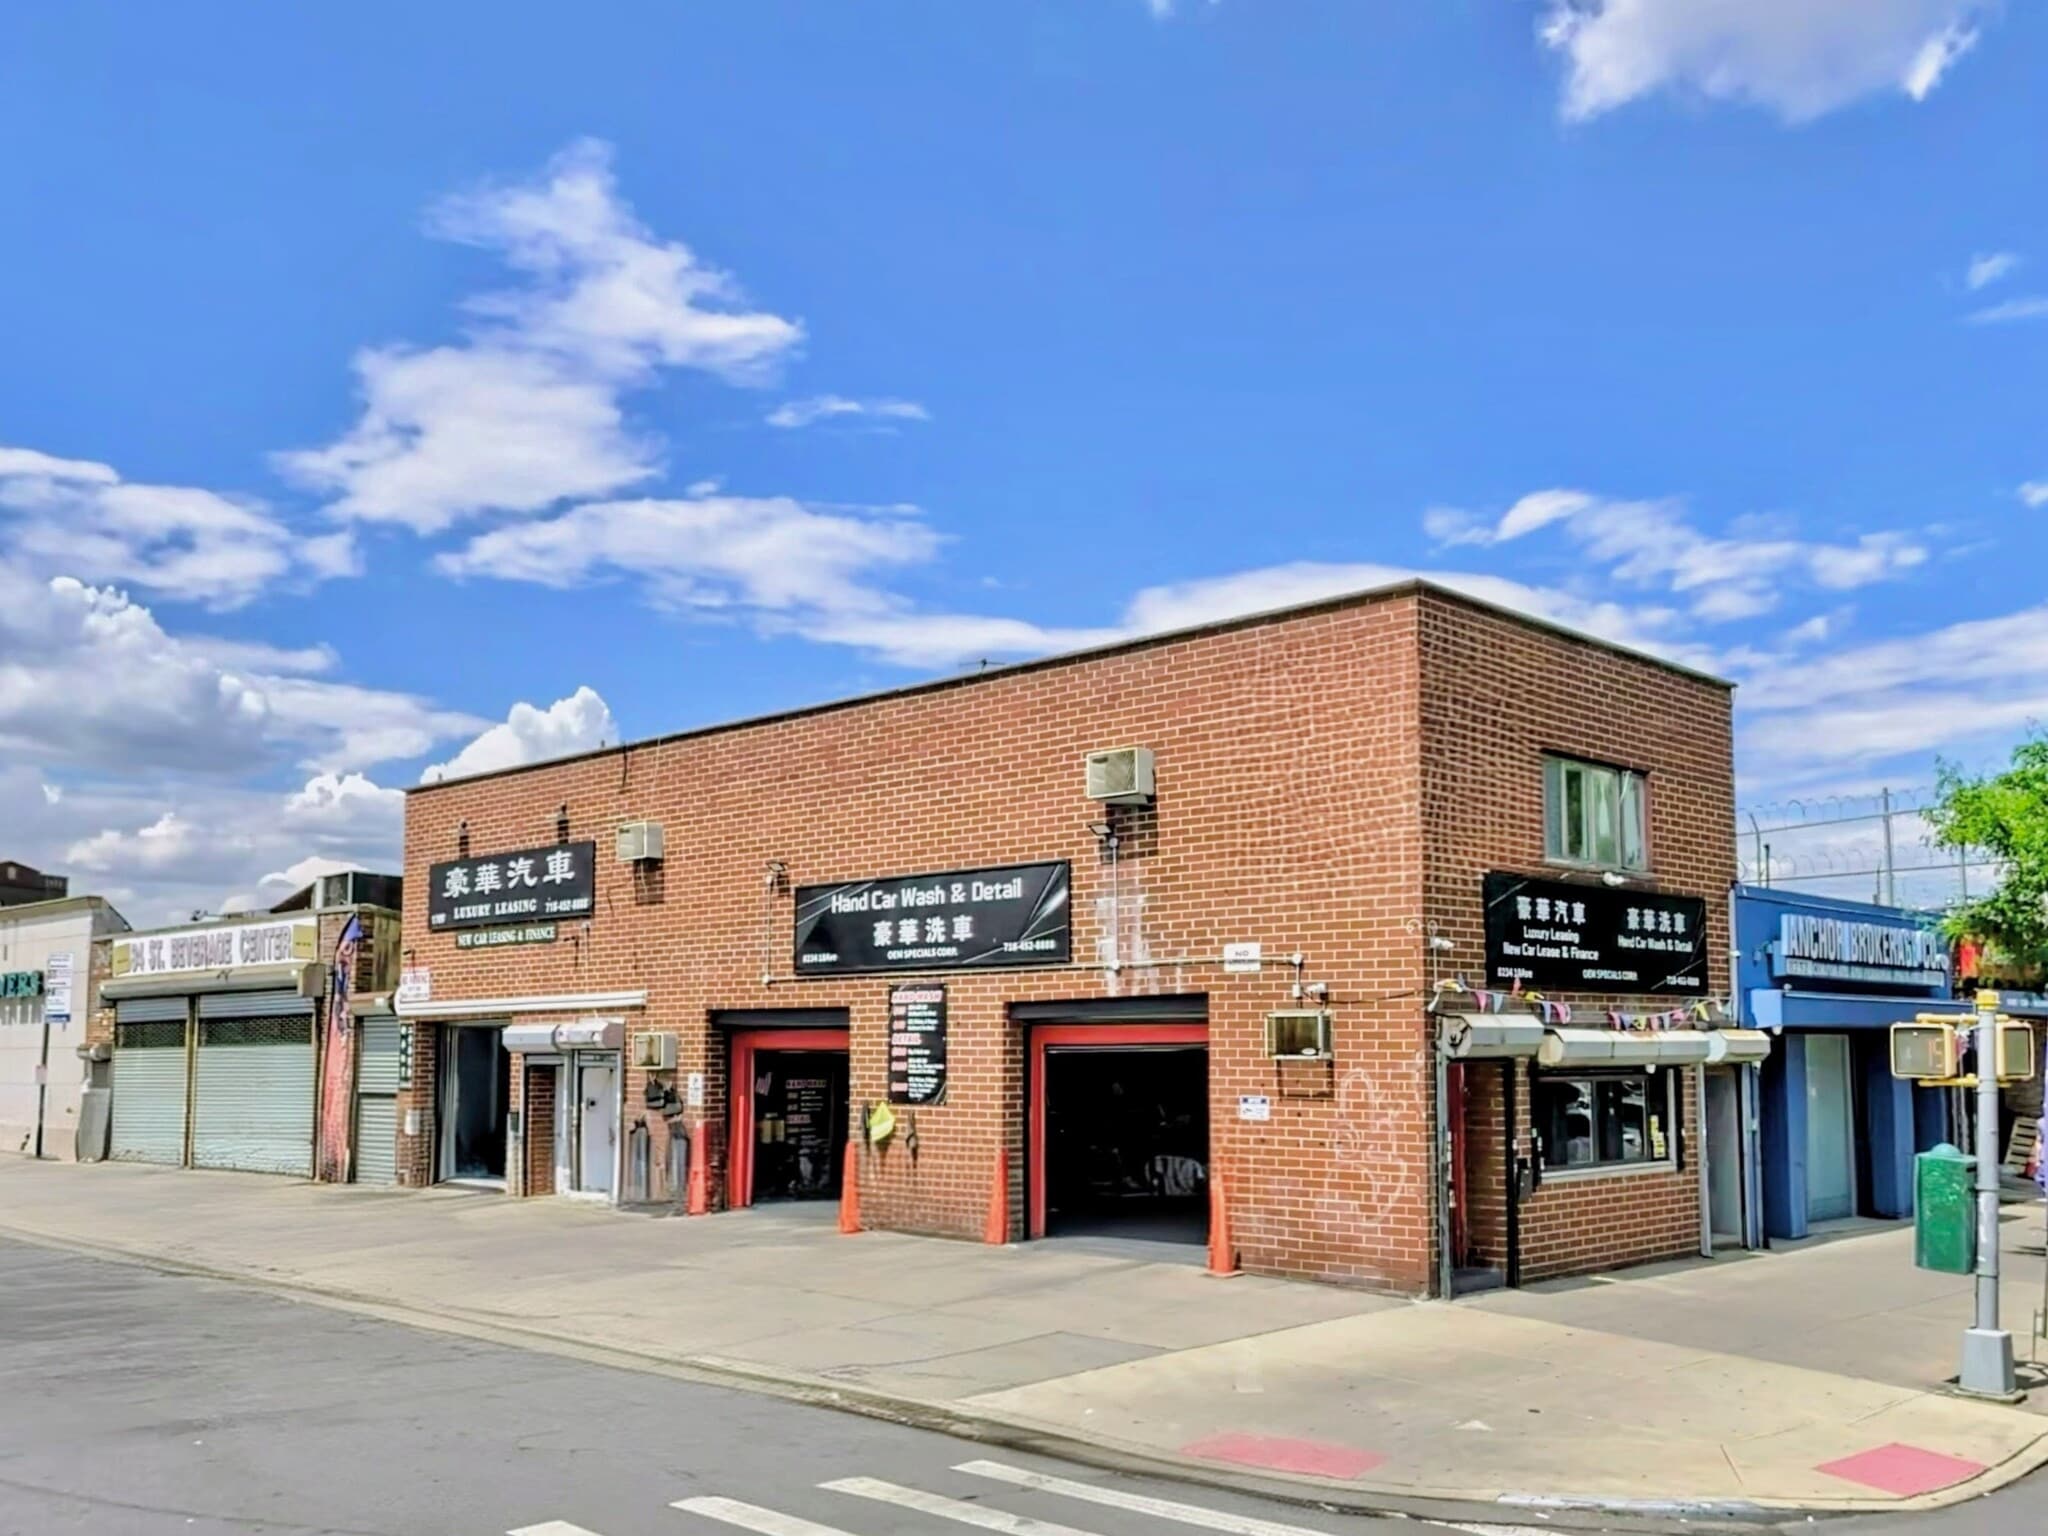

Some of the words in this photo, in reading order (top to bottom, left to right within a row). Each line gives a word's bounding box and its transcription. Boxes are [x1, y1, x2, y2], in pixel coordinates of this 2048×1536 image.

[442, 850, 576, 899] 豪華汽車
[453, 903, 491, 920] LUXURY
[495, 898, 538, 915] LEASING
[831, 892, 868, 914] Hand
[871, 889, 898, 911] Car
[901, 885, 945, 908] Wash
[951, 882, 967, 904] &
[972, 877, 1022, 902] Detail
[170, 931, 234, 969] BEVERAGE
[239, 925, 293, 964] CENTER
[457, 934, 472, 947] NEW
[473, 932, 488, 945] CAR
[489, 929, 517, 944] LEASING
[526, 926, 555, 941] FINANCE
[873, 914, 974, 947] 豪華洗車
[1523, 925, 1549, 941] Luxury
[1550, 927, 1580, 944] Leasing
[1788, 915, 1848, 961] ANCHOR
[1503, 941, 1521, 956] New
[1522, 943, 1536, 956] Car
[1570, 946, 1600, 961] Finance
